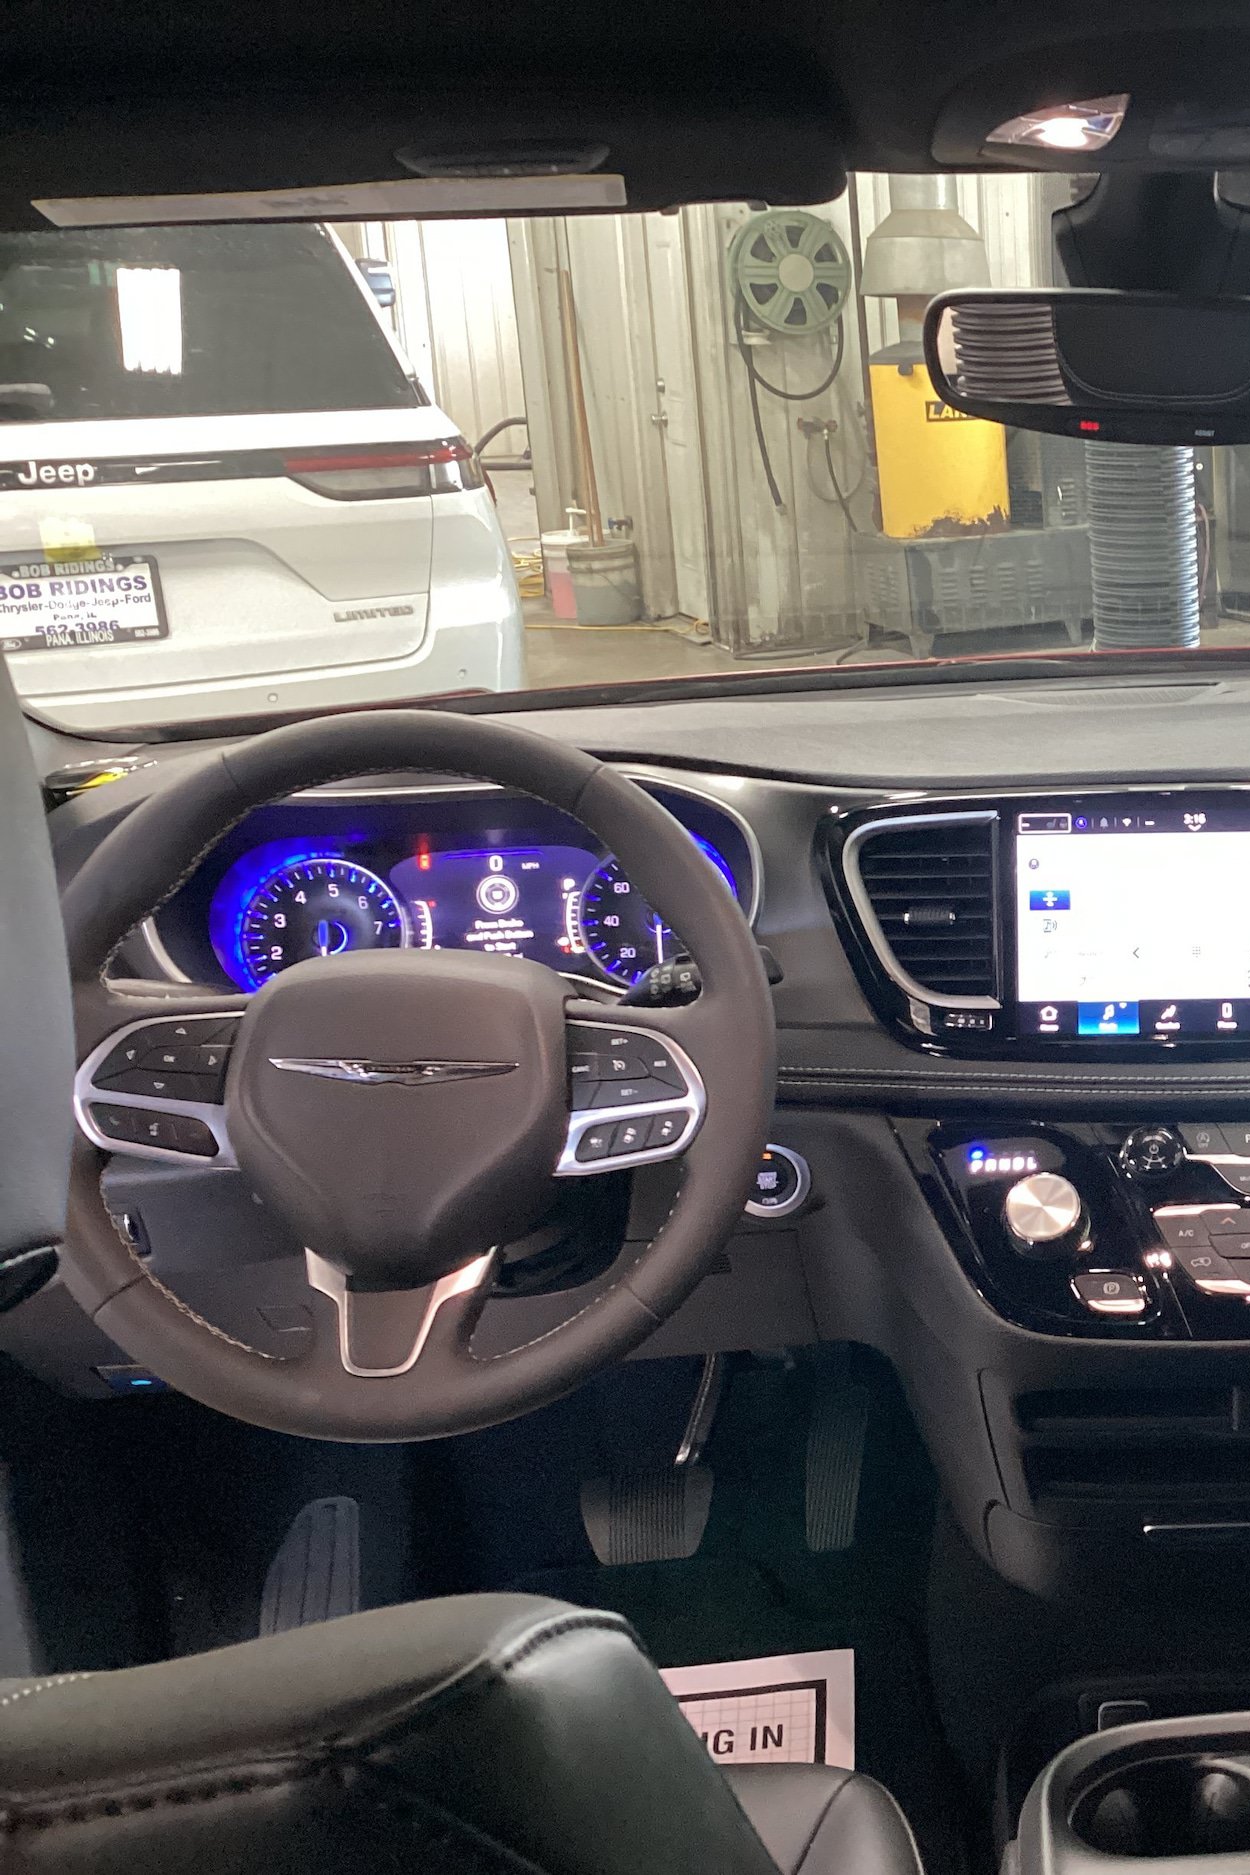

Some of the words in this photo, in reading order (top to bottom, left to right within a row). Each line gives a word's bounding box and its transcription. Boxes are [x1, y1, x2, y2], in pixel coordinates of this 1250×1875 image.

[18, 461, 95, 487] Jeep
[18, 564, 51, 578] BOB
[54, 559, 115, 576] RIDINGS
[49, 575, 147, 597] RIDINGS
[333, 606, 414, 623] LIMITED
[76, 630, 114, 644] ILLINOIS
[328, 884, 340, 898] 5
[613, 882, 630, 894] 60
[295, 891, 307, 905] 4
[358, 896, 369, 909] 6
[273, 913, 287, 929] 3
[374, 921, 383, 935] 7
[603, 915, 620, 927] 40
[270, 945, 283, 960] 2
[619, 947, 636, 958] 20
[1178, 1229, 1194, 1237] A/C
[749, 1723, 784, 1751] IN
